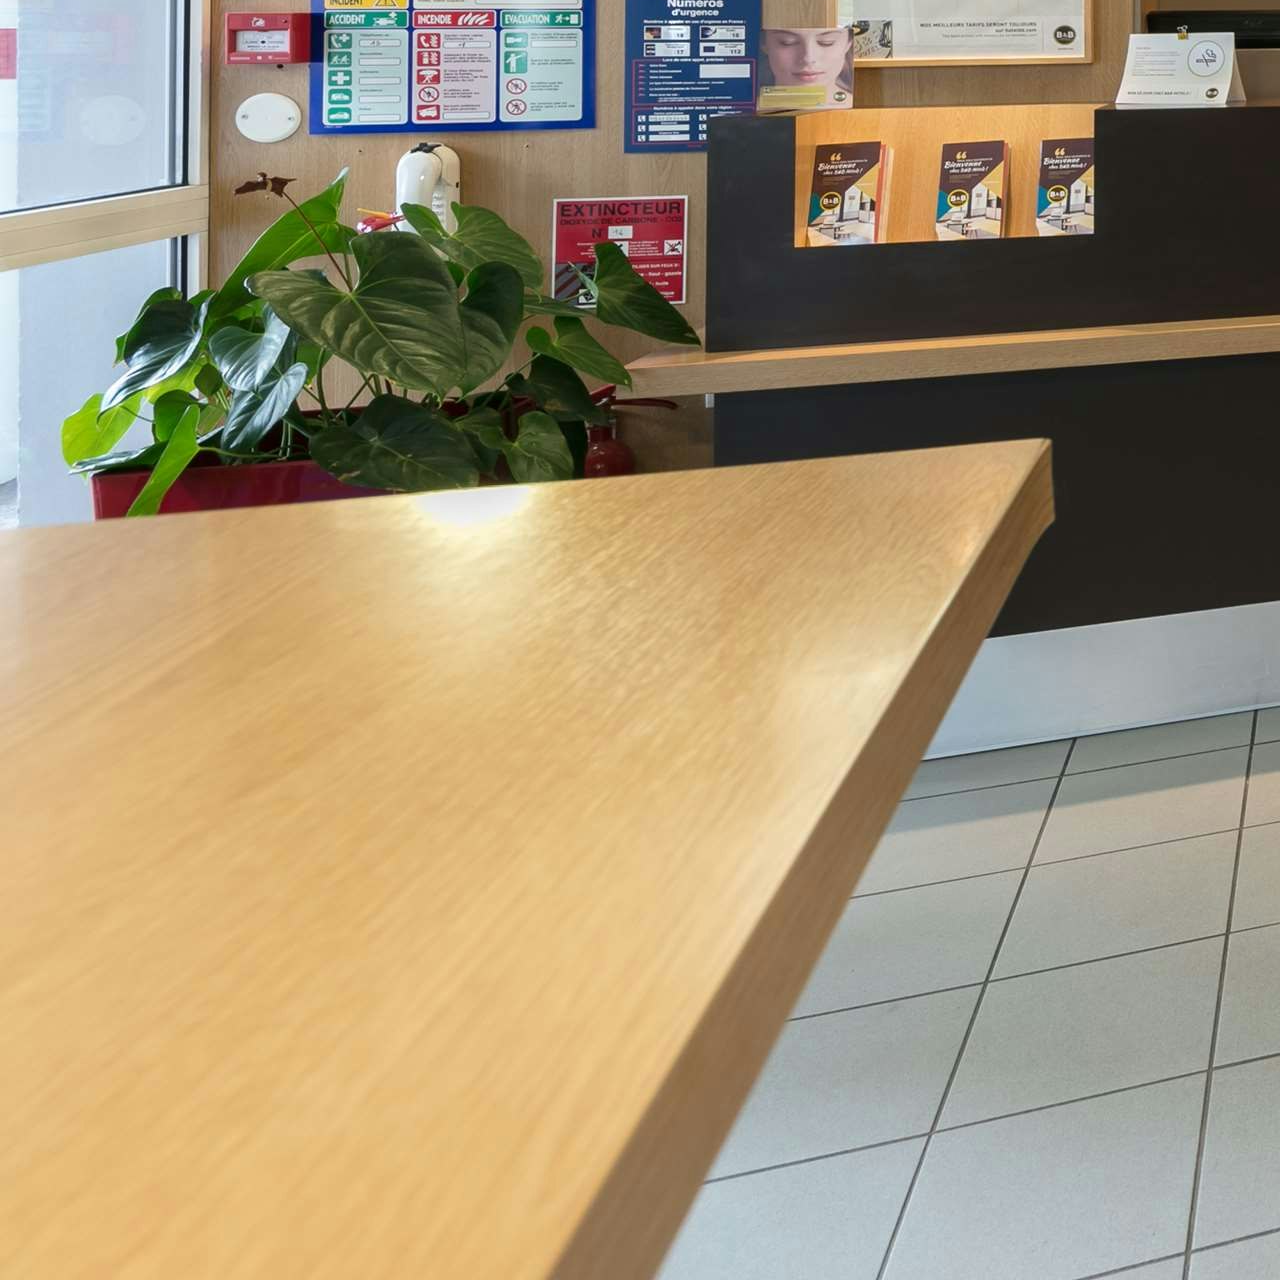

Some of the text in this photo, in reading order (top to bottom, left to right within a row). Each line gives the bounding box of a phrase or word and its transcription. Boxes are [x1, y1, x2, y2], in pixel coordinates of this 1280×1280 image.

[672, 9, 719, 18] d'urgence
[329, 14, 366, 24] ACCIDENT
[417, 14, 451, 25] INCENDIE
[504, 14, 550, 24] EVACUATION
[560, 202, 681, 217] EXTINCTEUR
